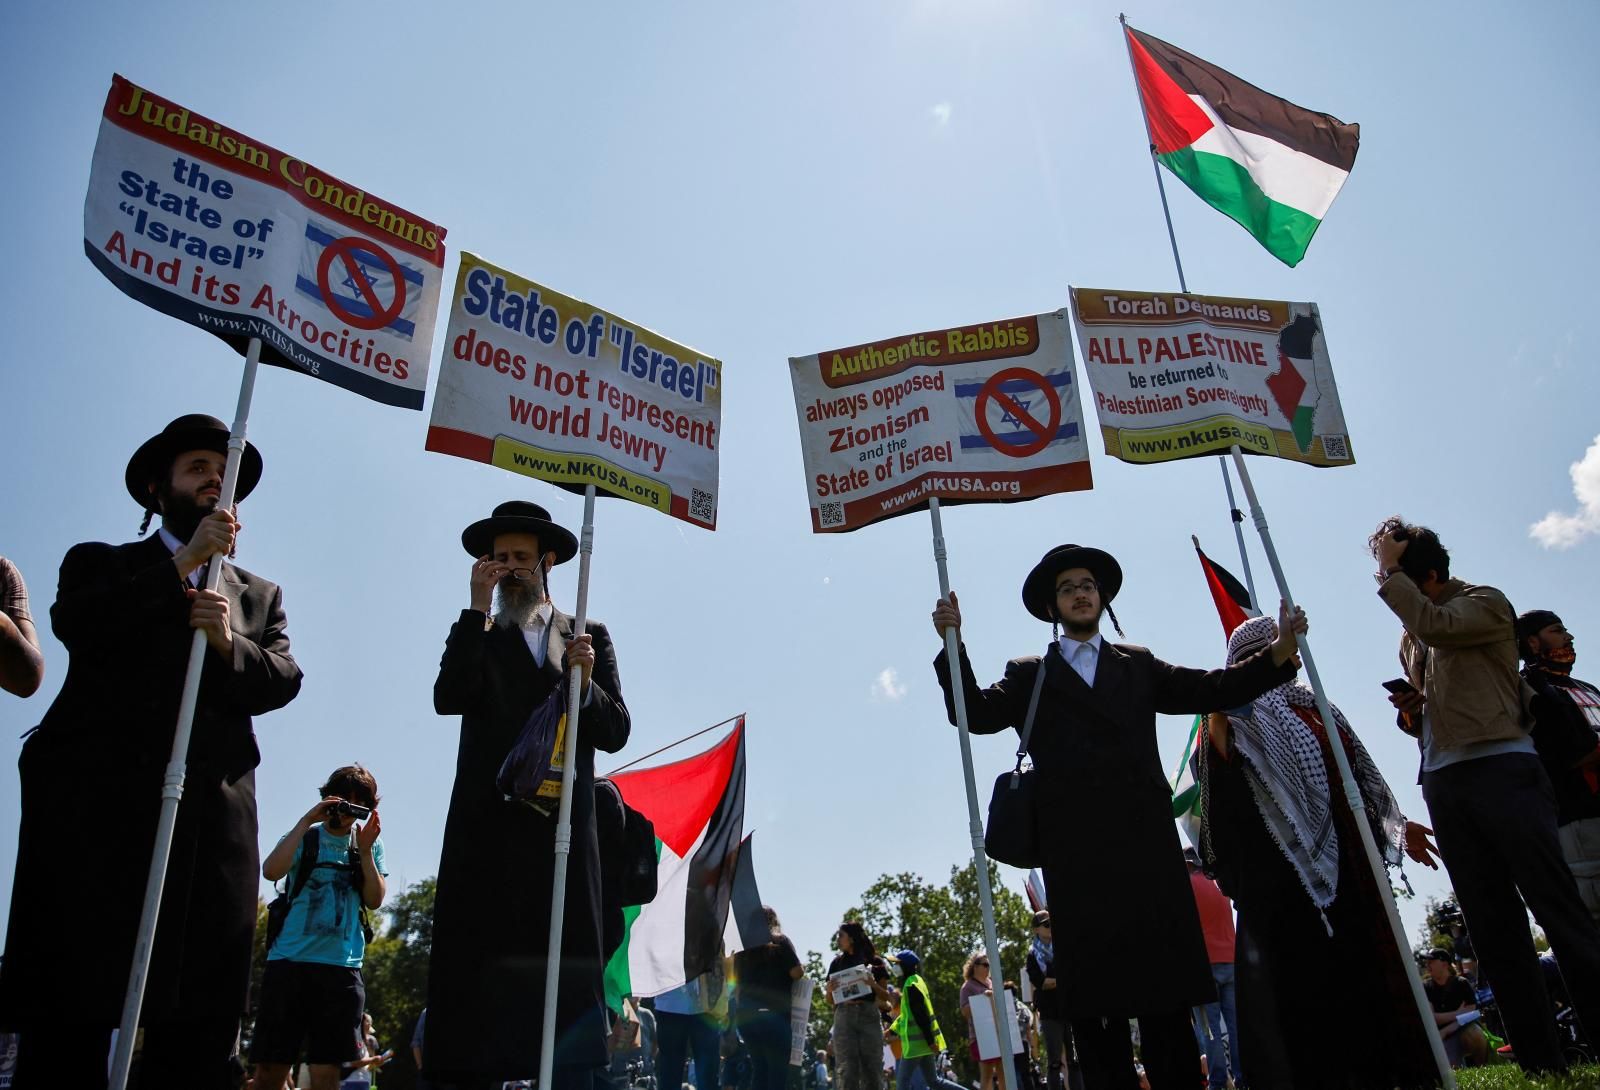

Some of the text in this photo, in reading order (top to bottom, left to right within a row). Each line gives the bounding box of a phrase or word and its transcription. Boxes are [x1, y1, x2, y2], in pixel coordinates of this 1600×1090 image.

[118, 84, 438, 251] Judaism Condemns
[173, 157, 234, 201] the
[118, 169, 274, 244] State of
[105, 230, 410, 381] And its Atrocities
[463, 268, 558, 345] State
[565, 314, 604, 358] of
[1104, 295, 1271, 323] Torah Demands
[198, 312, 321, 375] www.NKUSA.org
[830, 322, 1030, 379] Authentic Rabbis
[1088, 332, 1269, 367] ALL PALESTINE
[453, 328, 716, 451] does not represent
[806, 370, 945, 424] always opposed
[1097, 386, 1269, 417] Palestinian Sovereignty
[1128, 362, 1228, 389] be returned to
[508, 394, 667, 473] world Jewry
[828, 404, 930, 454] Zionism
[858, 437, 908, 463] and the
[1128, 424, 1269, 456] www.nkusa.org
[513, 452, 660, 505] www.NKUSA.org
[815, 441, 953, 497] State of Israel
[880, 478, 1021, 511] www.NKUSA.org
